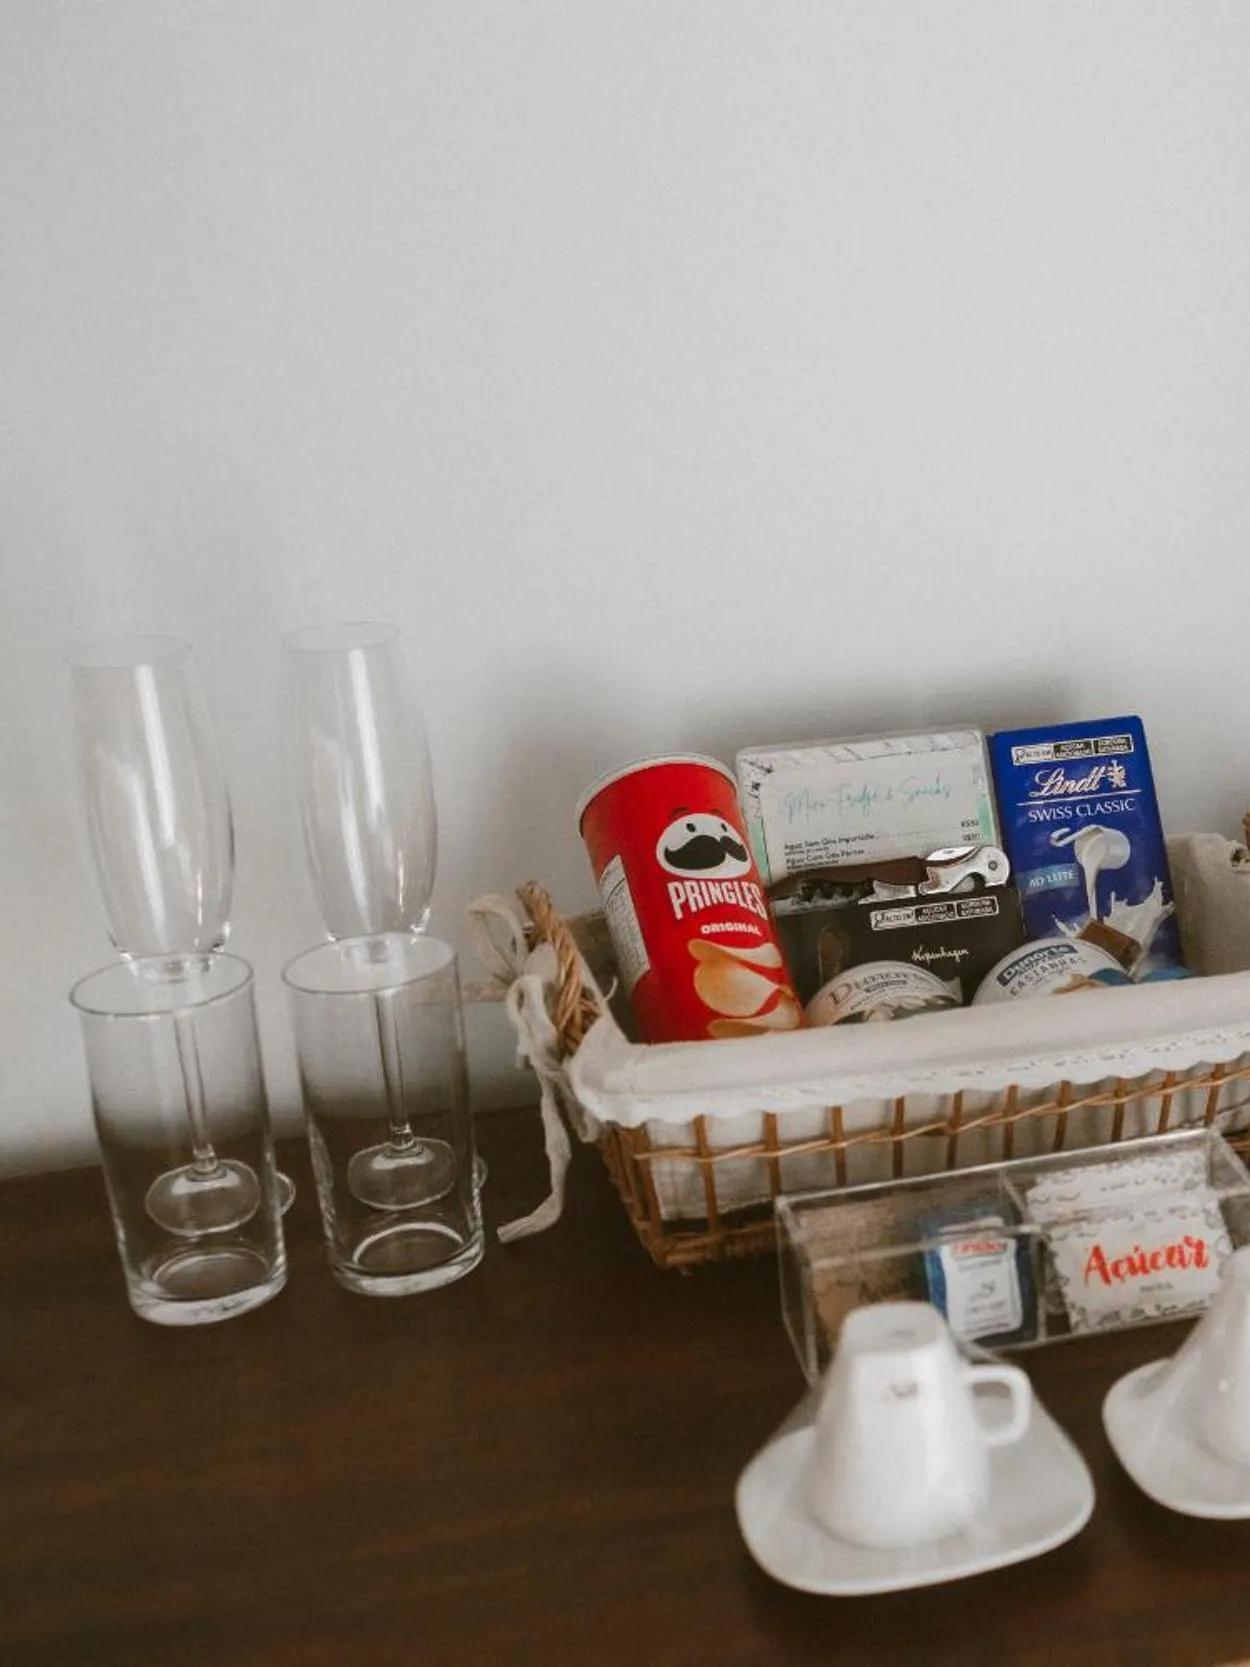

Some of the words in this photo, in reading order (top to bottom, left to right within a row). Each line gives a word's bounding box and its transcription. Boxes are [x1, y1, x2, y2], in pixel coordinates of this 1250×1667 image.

[1028, 766, 1106, 798] Lindt
[1028, 806, 1073, 823] SWISS
[1076, 798, 1137, 818] CLASSIC
[1047, 869, 1075, 884] LEITE
[667, 879, 769, 921] PRINGLES
[701, 922, 763, 937] ORIGINAL
[911, 944, 969, 965] Kopenhagen
[1084, 1235, 1209, 1288] Açúcar
